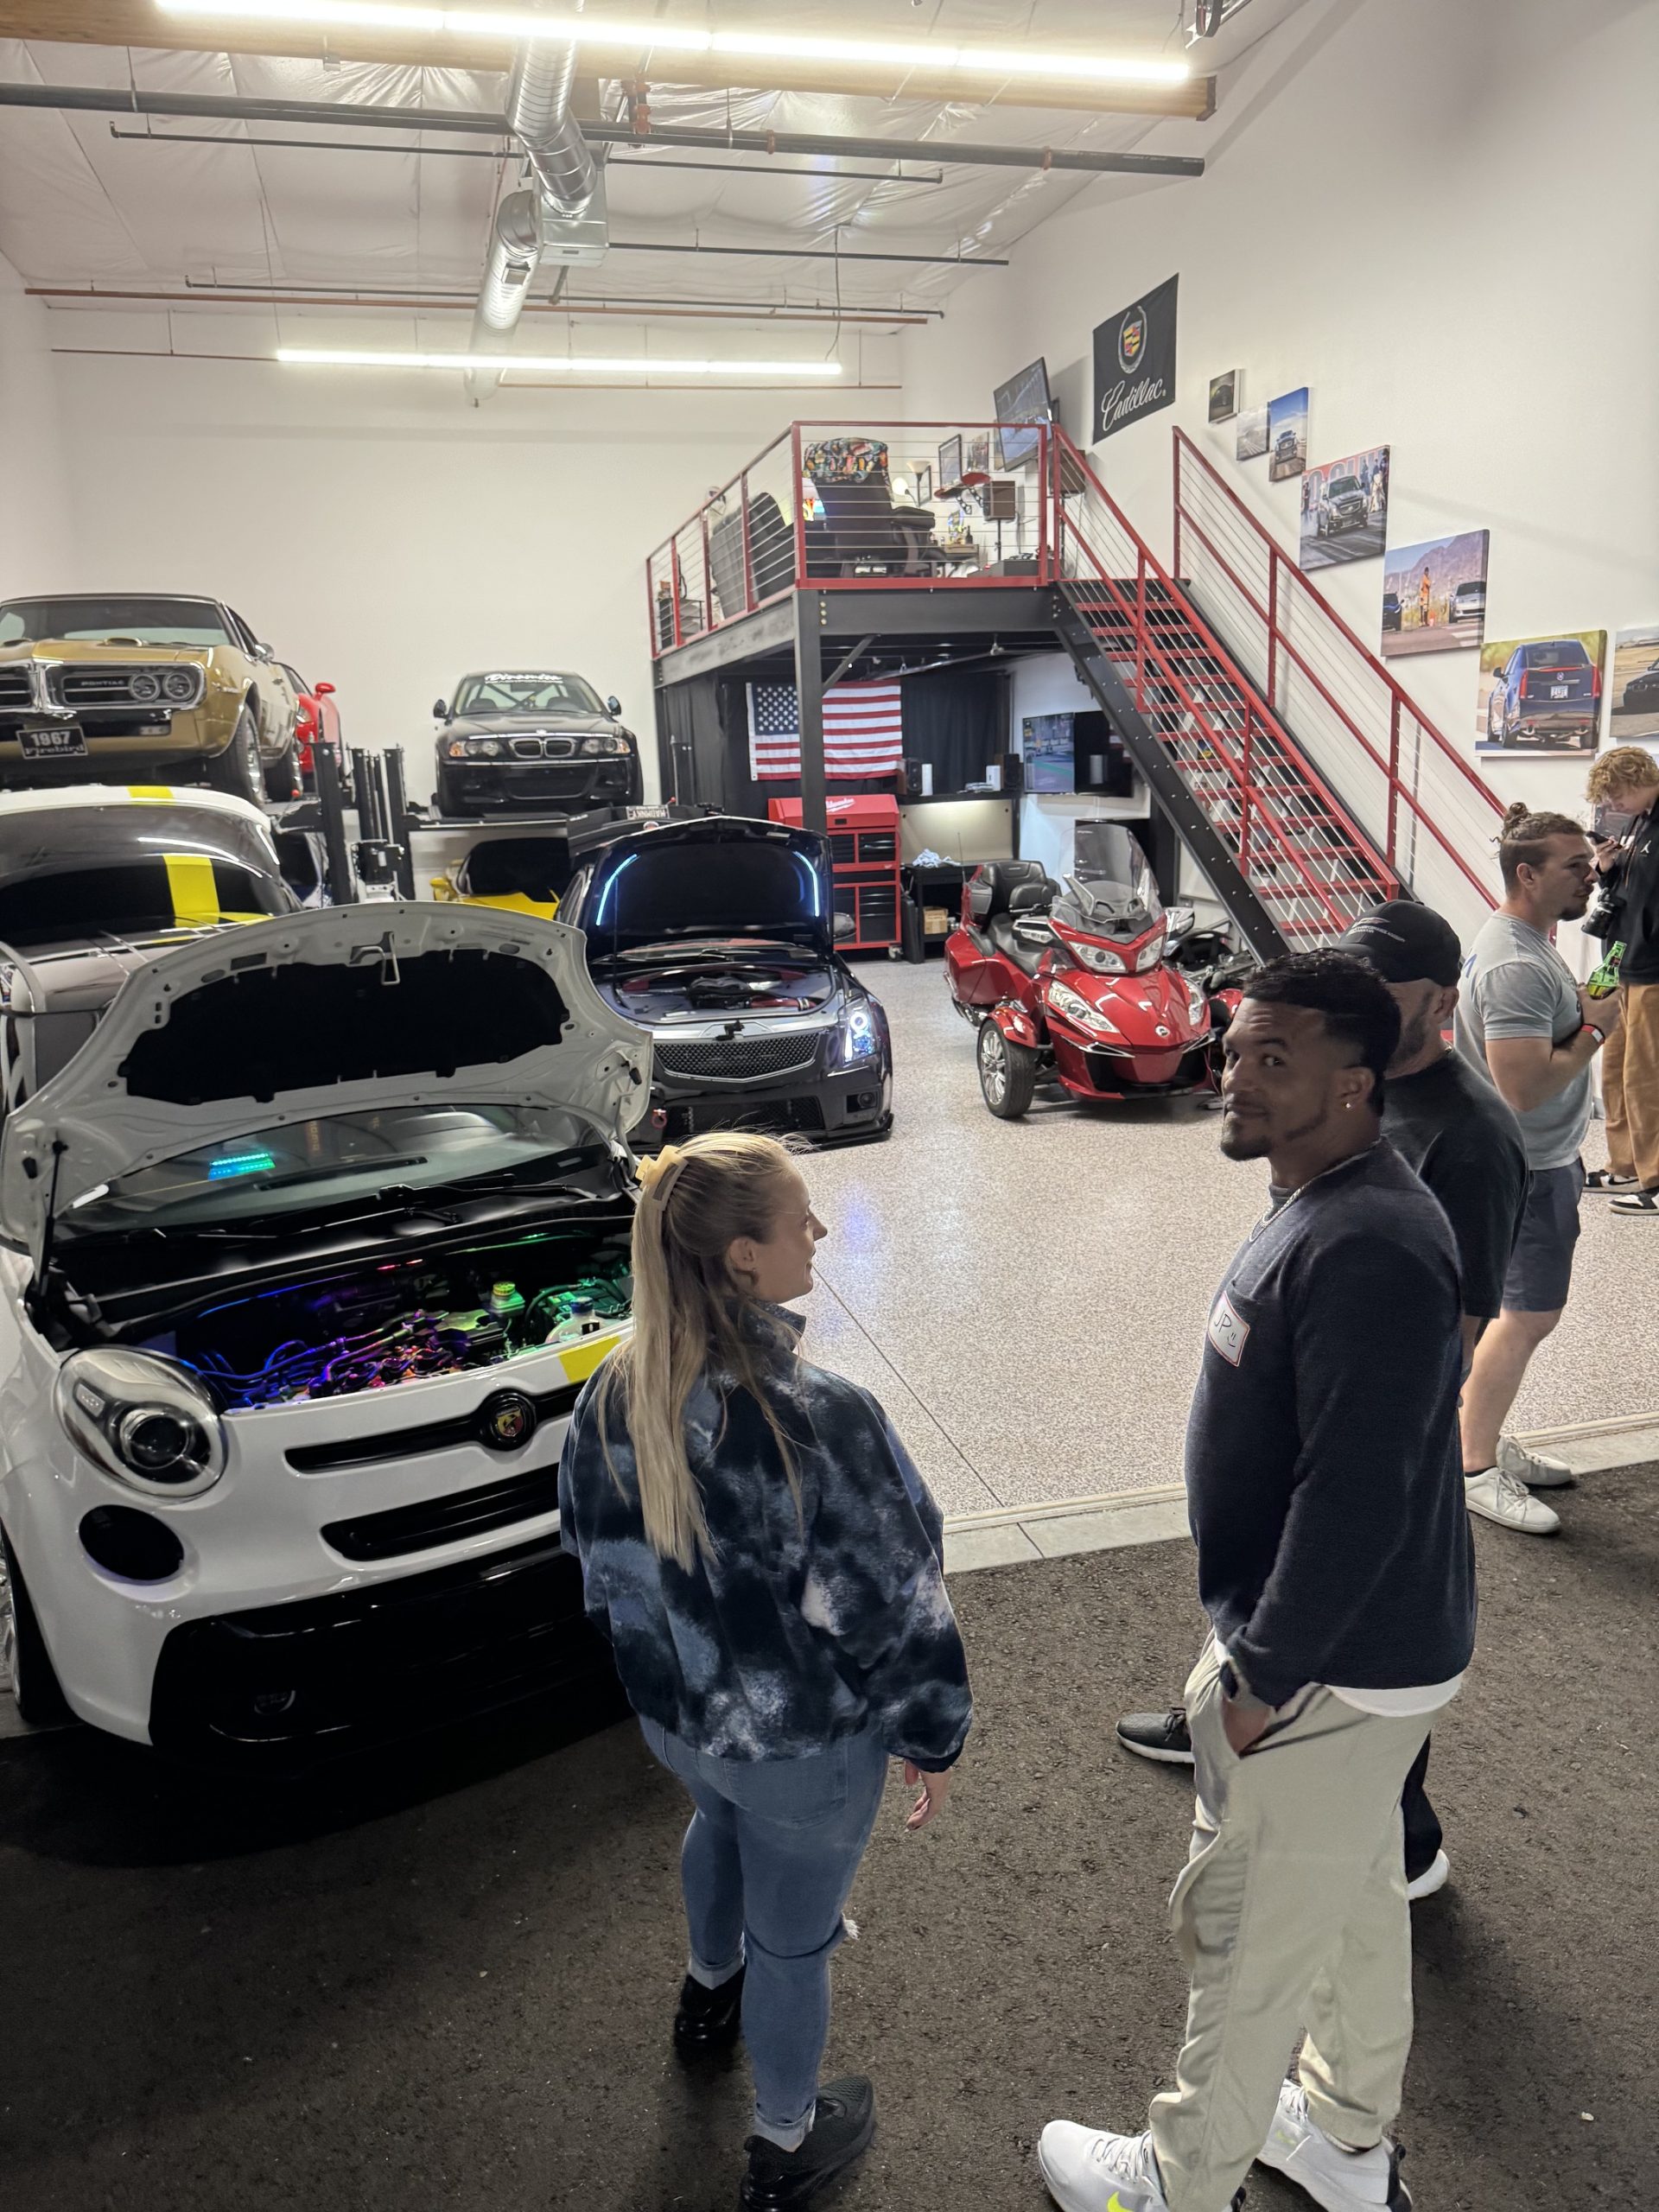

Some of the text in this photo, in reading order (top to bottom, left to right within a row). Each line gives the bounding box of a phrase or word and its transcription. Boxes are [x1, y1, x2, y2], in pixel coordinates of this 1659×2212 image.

[1101, 378, 1163, 432] Cadillac
[30, 730, 71, 747] 1967
[25, 744, 85, 754] Firebird
[1214, 1310, 1232, 1332] JP
